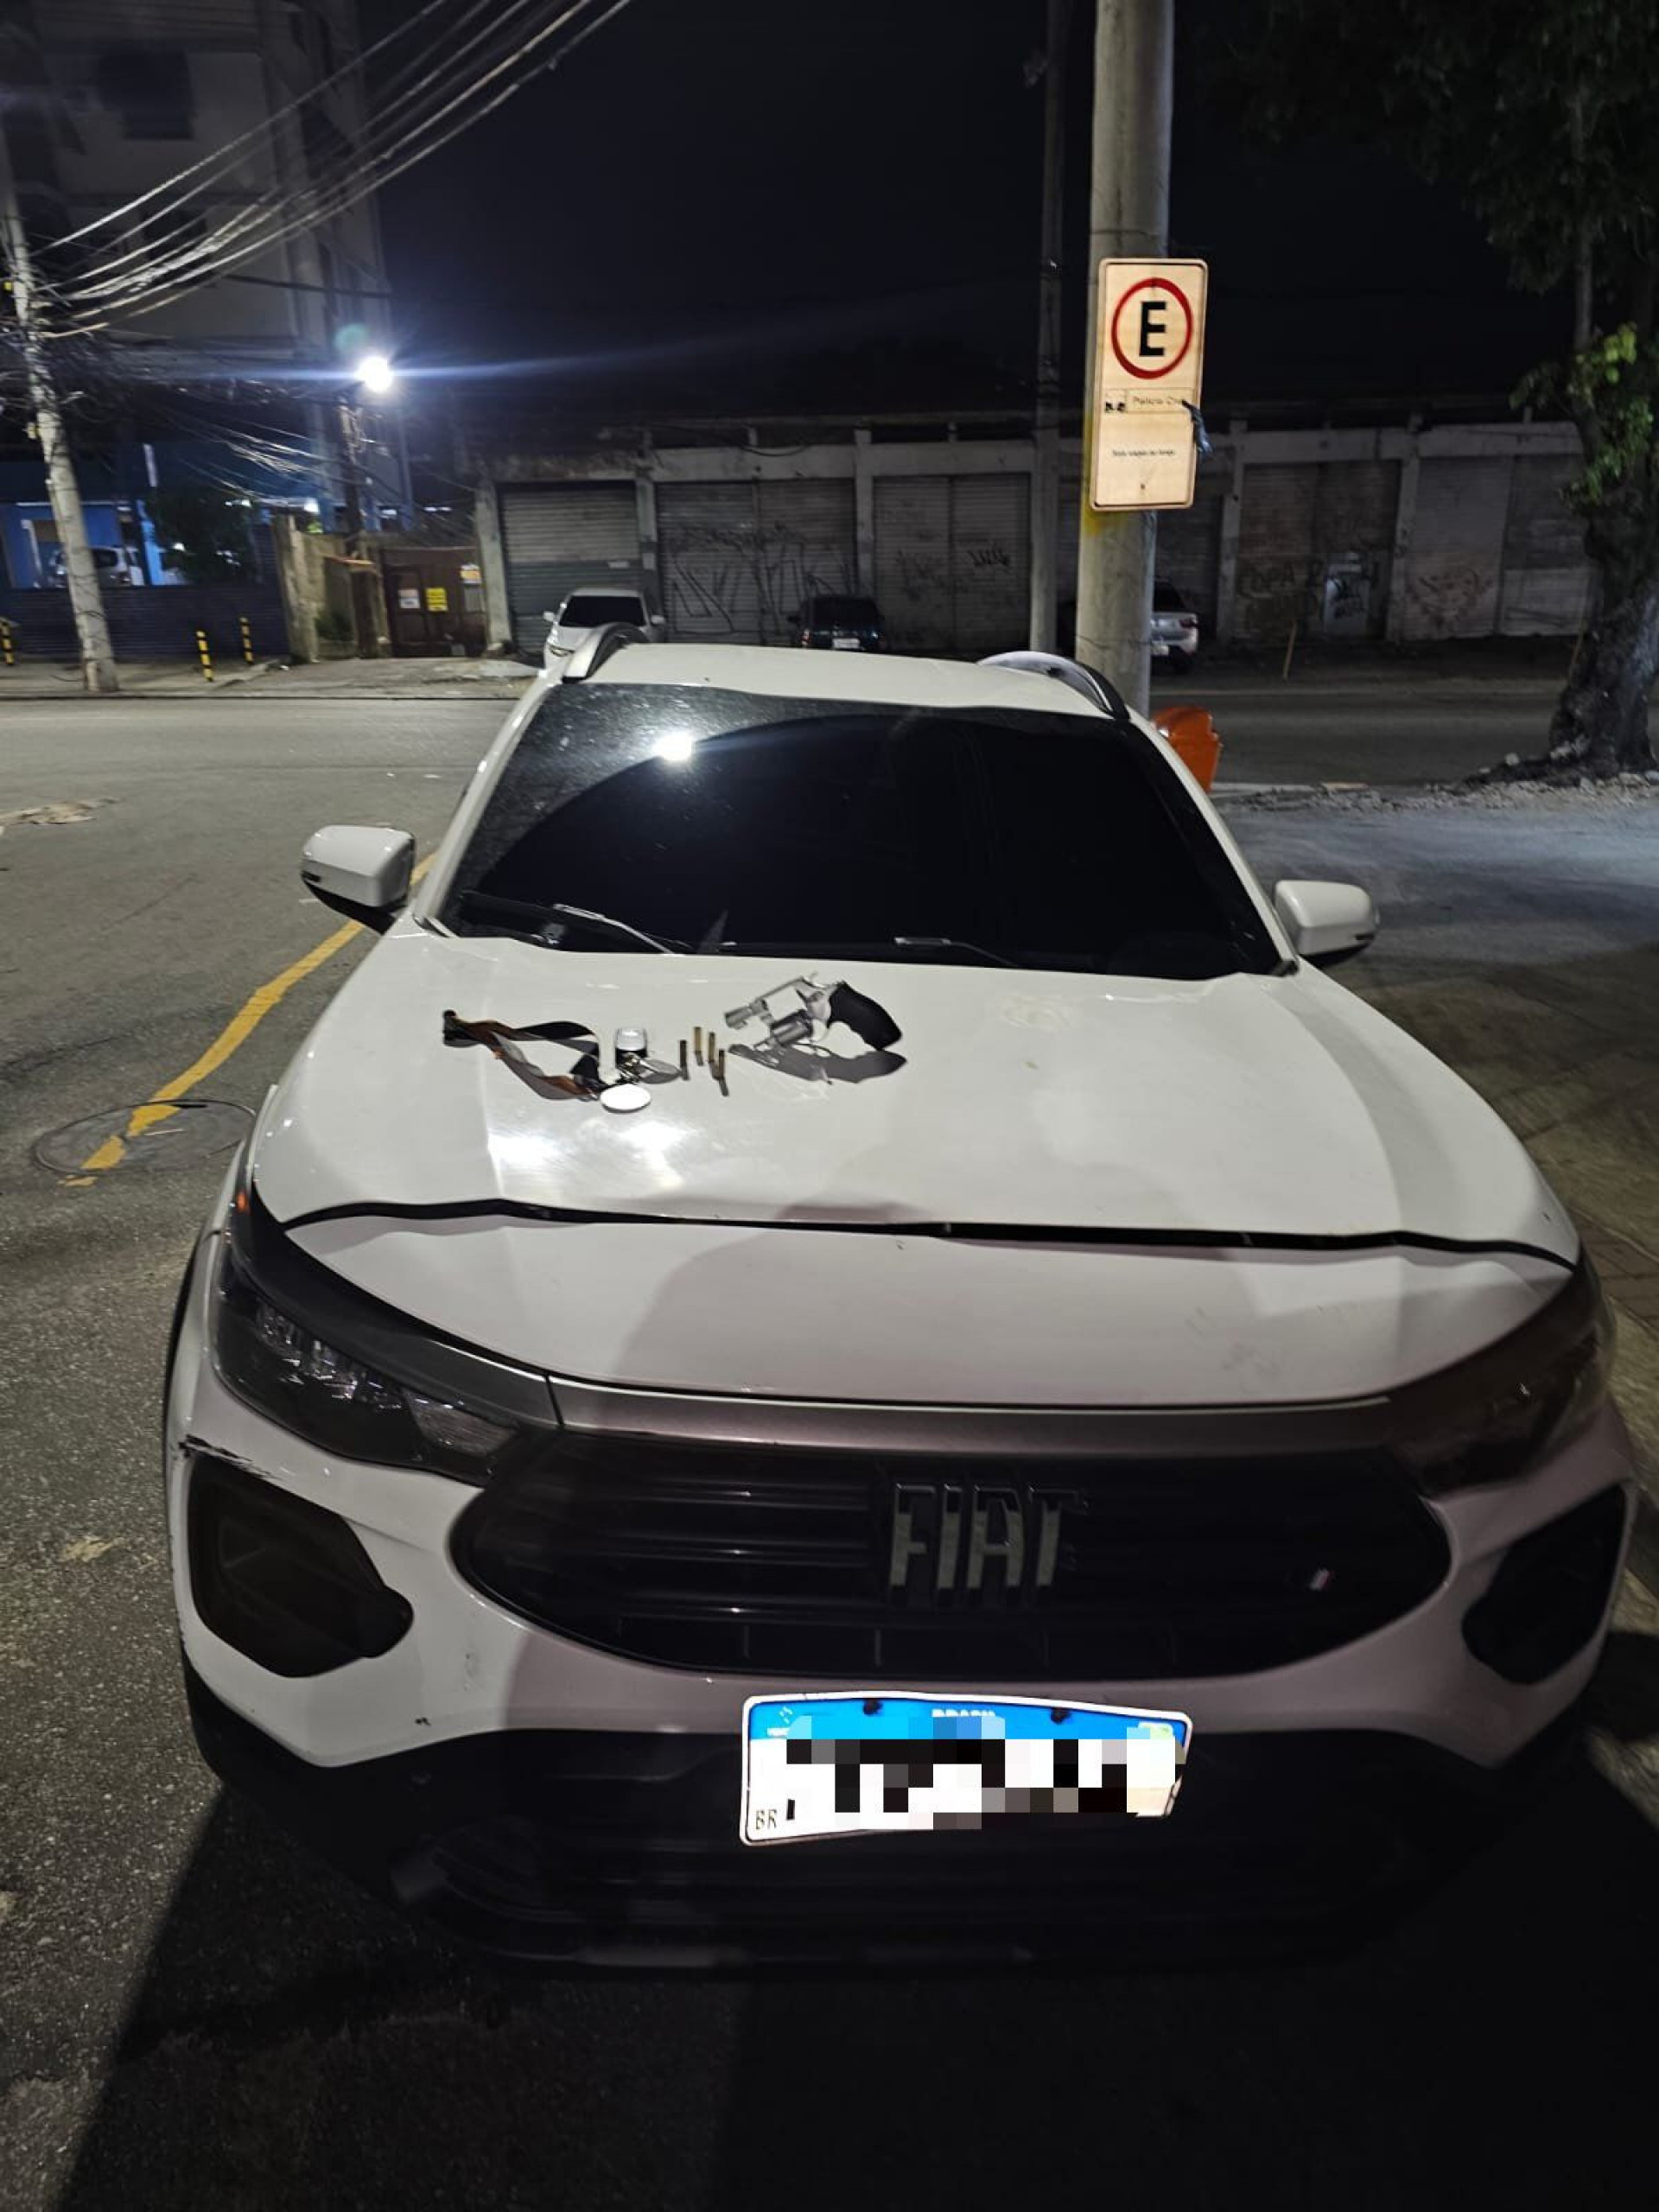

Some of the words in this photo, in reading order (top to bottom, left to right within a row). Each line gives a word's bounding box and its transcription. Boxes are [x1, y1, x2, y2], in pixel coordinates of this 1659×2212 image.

[1139, 301, 1166, 357] E
[889, 1483, 1079, 1590] FIAT
[755, 1809, 777, 1829] BR
